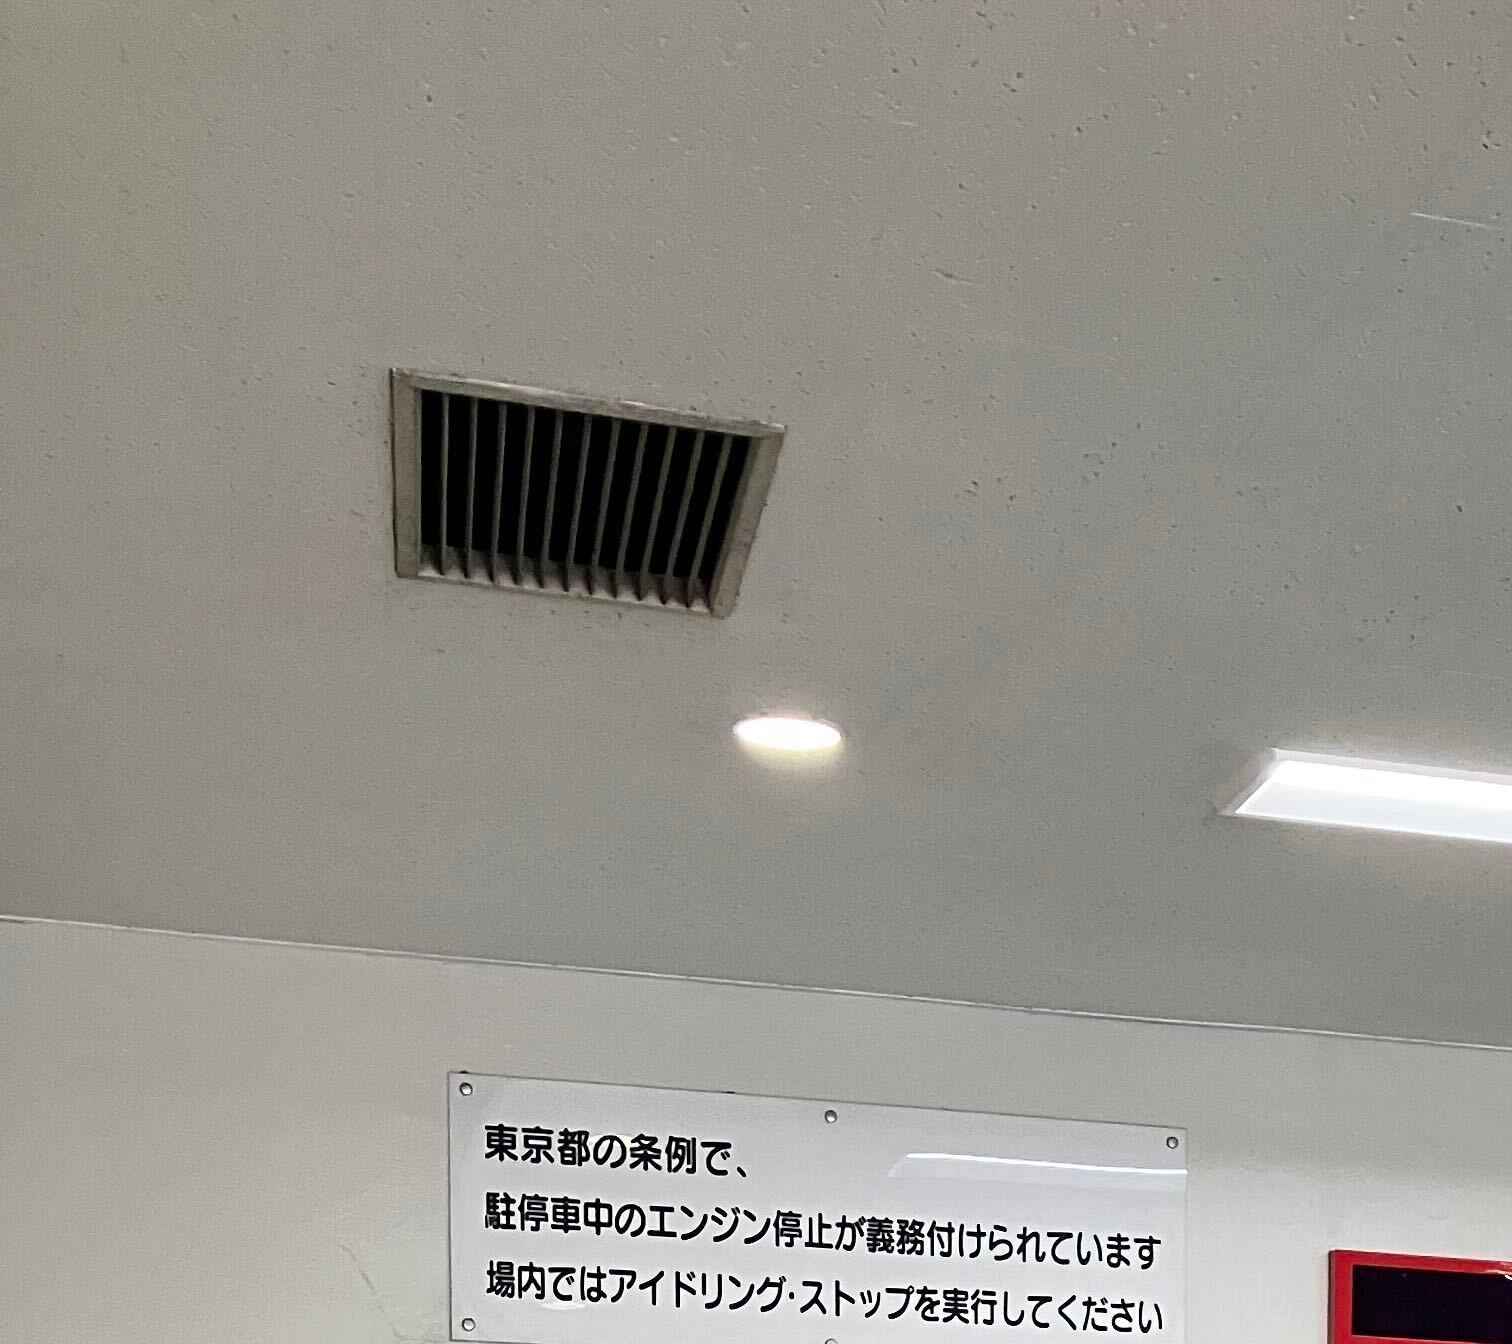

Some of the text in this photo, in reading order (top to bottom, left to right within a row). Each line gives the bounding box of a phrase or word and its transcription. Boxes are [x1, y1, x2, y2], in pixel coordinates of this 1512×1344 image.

[484, 1124, 748, 1179] 東京都の条例で、
[484, 1193, 1161, 1271] 駐停車中のエンジン停止が義務付けられています
[486, 1261, 1163, 1334] 場内ではアイドリング・ストップを実行してください
